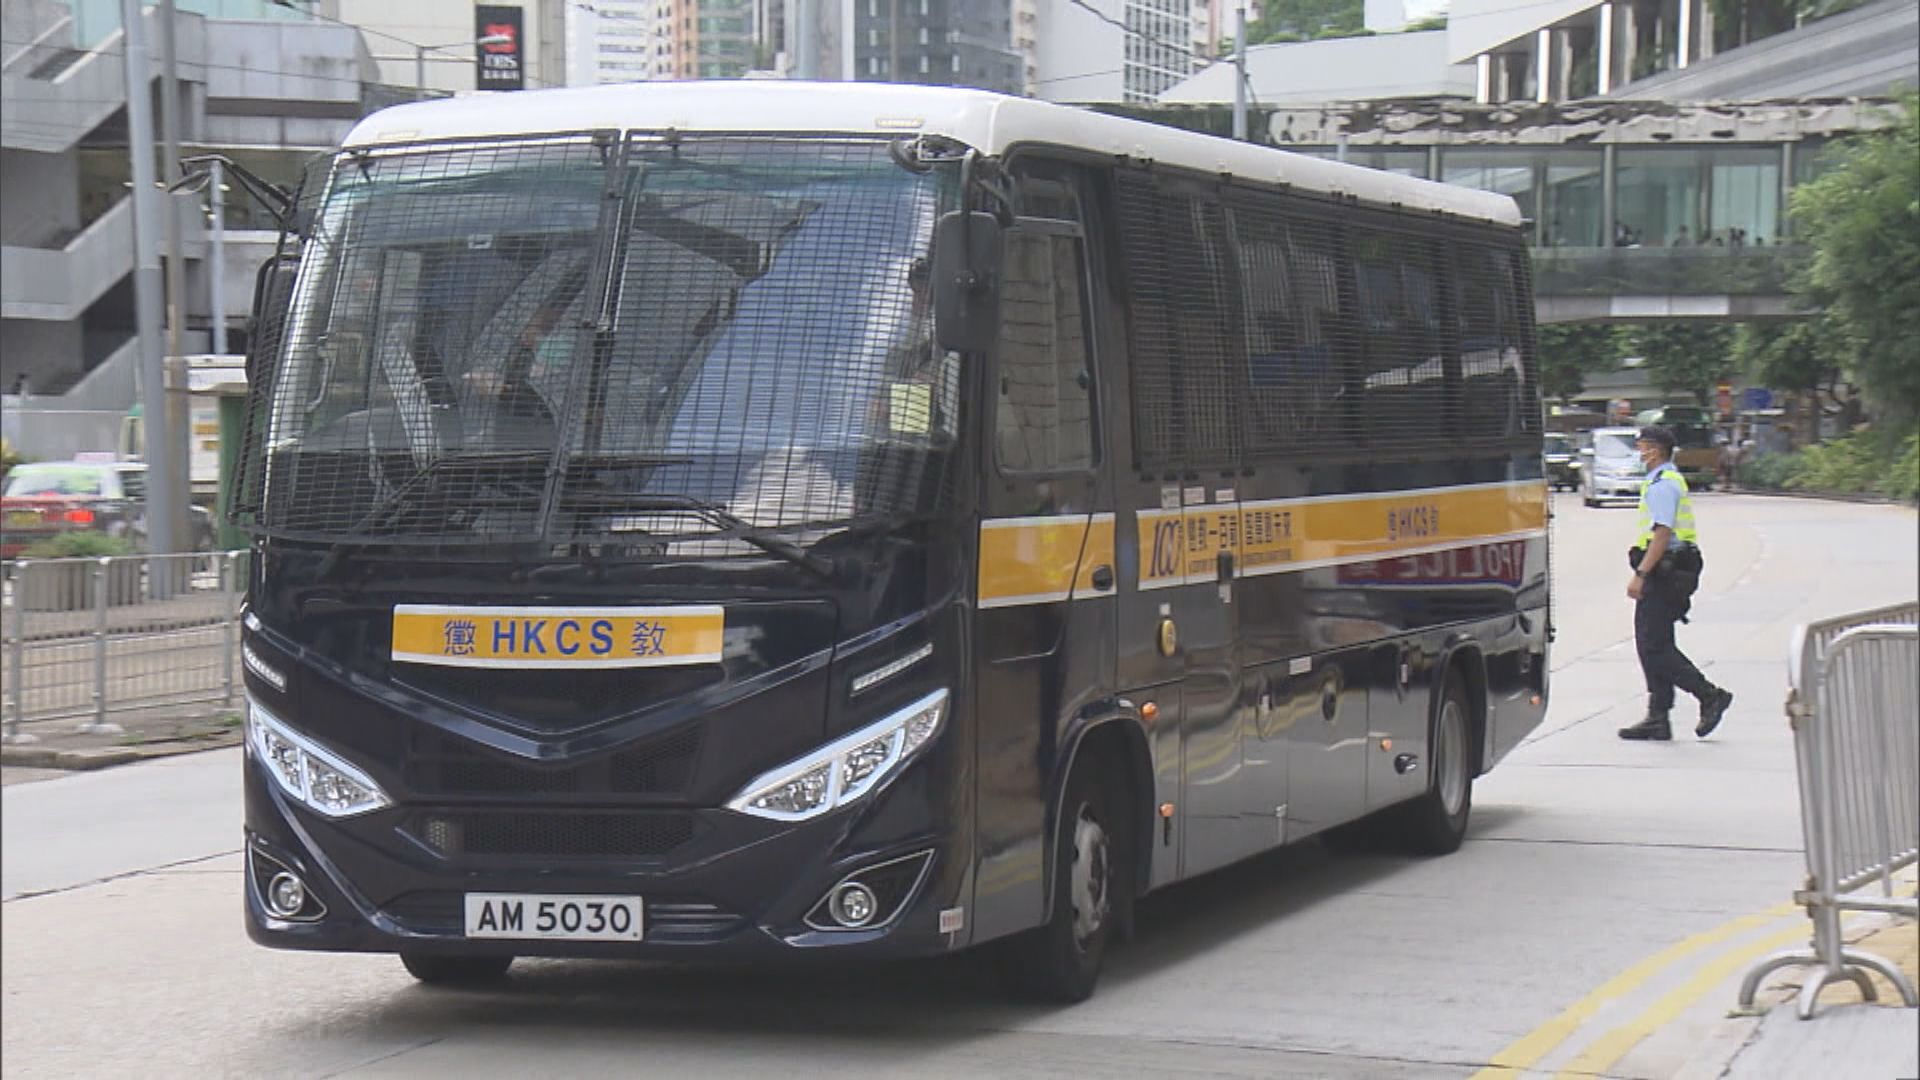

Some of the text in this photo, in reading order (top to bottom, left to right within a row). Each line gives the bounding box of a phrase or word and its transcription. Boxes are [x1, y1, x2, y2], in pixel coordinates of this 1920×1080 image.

[491, 619, 614, 656] HKCS
[478, 900, 632, 933] AM 5030
